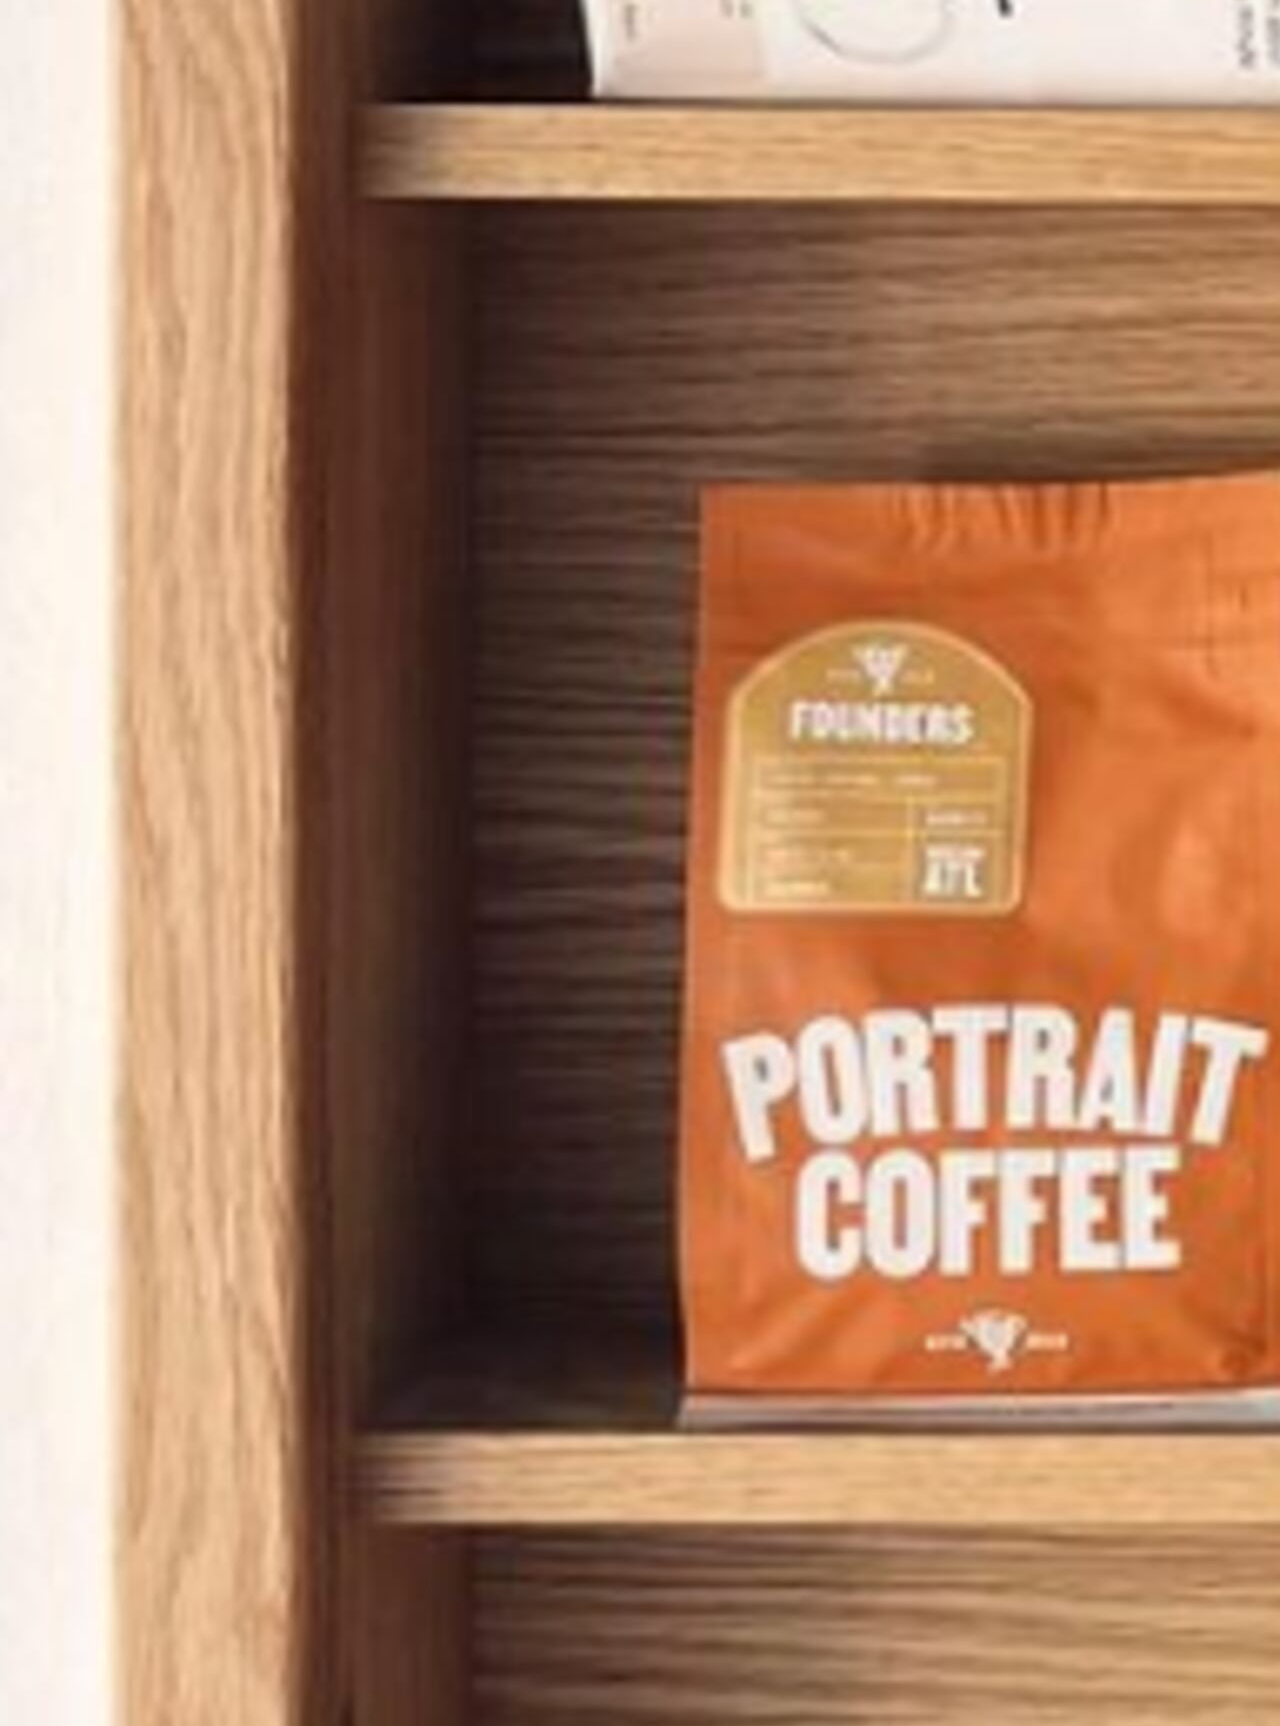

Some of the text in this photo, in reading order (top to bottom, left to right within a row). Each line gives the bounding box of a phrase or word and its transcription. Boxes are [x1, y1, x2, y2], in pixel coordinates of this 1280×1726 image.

[789, 699, 975, 745] FOUNDERS
[721, 1003, 1270, 1163] PORTRAIT
[795, 1145, 1182, 1280] COFFEE
